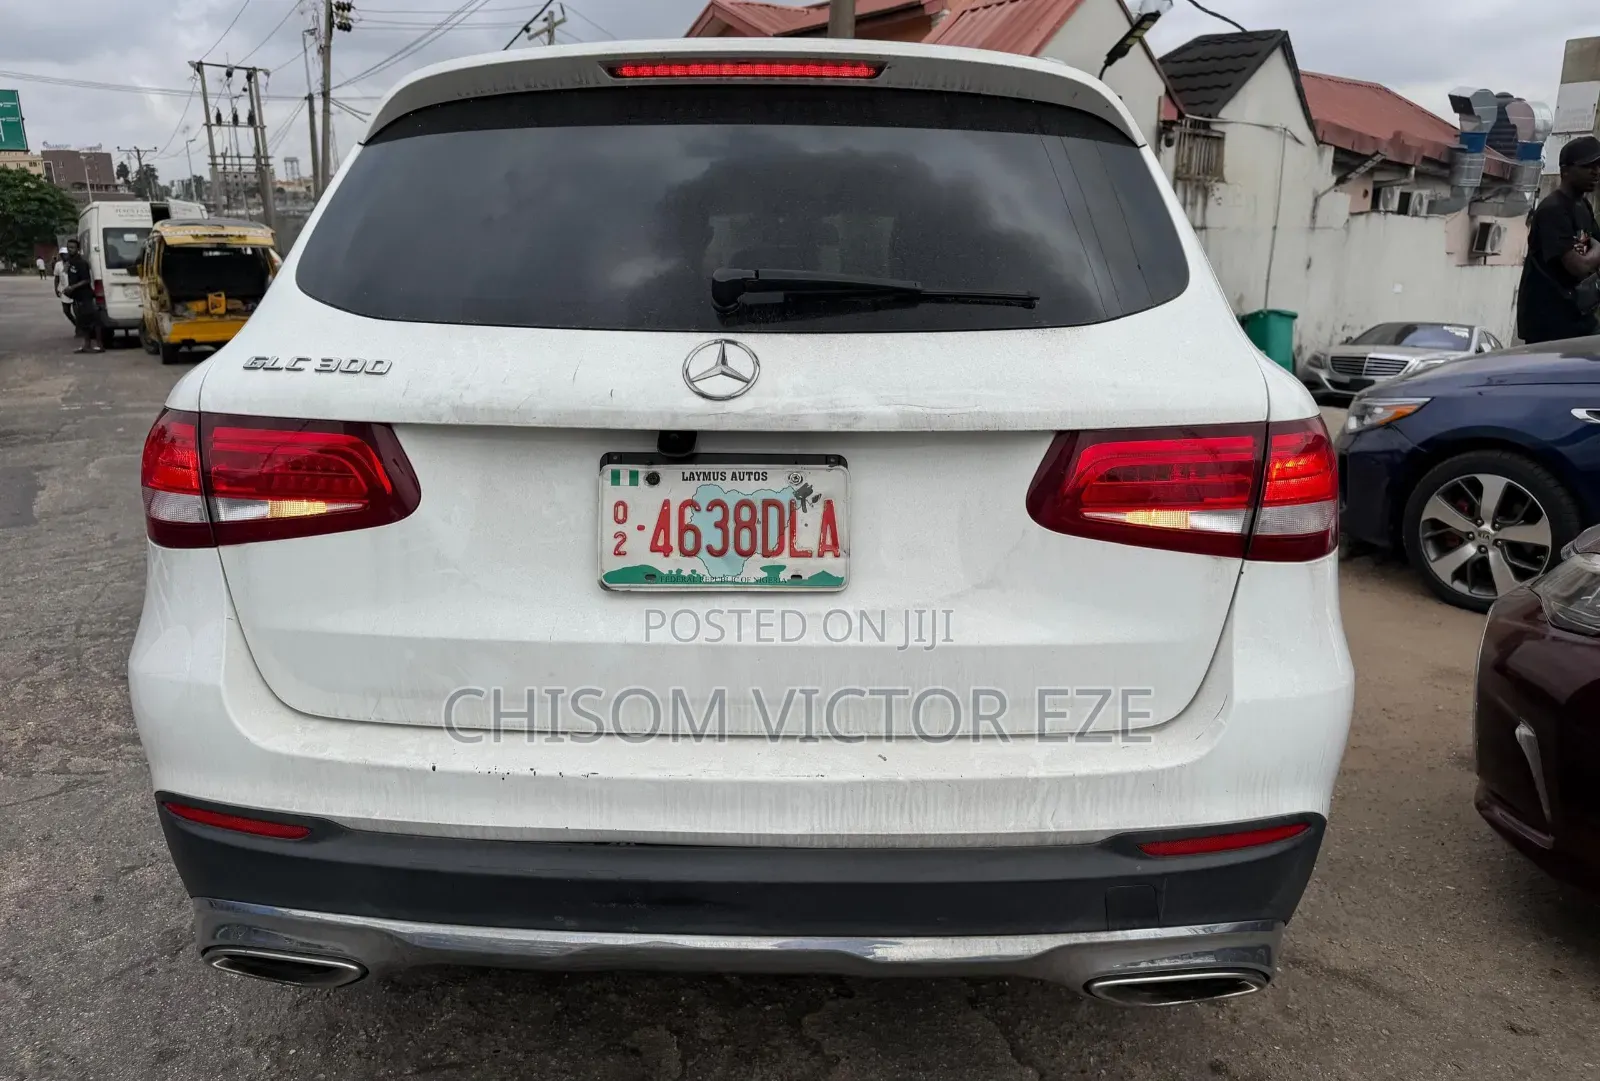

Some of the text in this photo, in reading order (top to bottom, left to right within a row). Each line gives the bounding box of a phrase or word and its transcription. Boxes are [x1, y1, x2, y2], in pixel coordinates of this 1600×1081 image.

[243, 356, 393, 375] GLC 300
[681, 471, 768, 482] LAYMUS AUTOS
